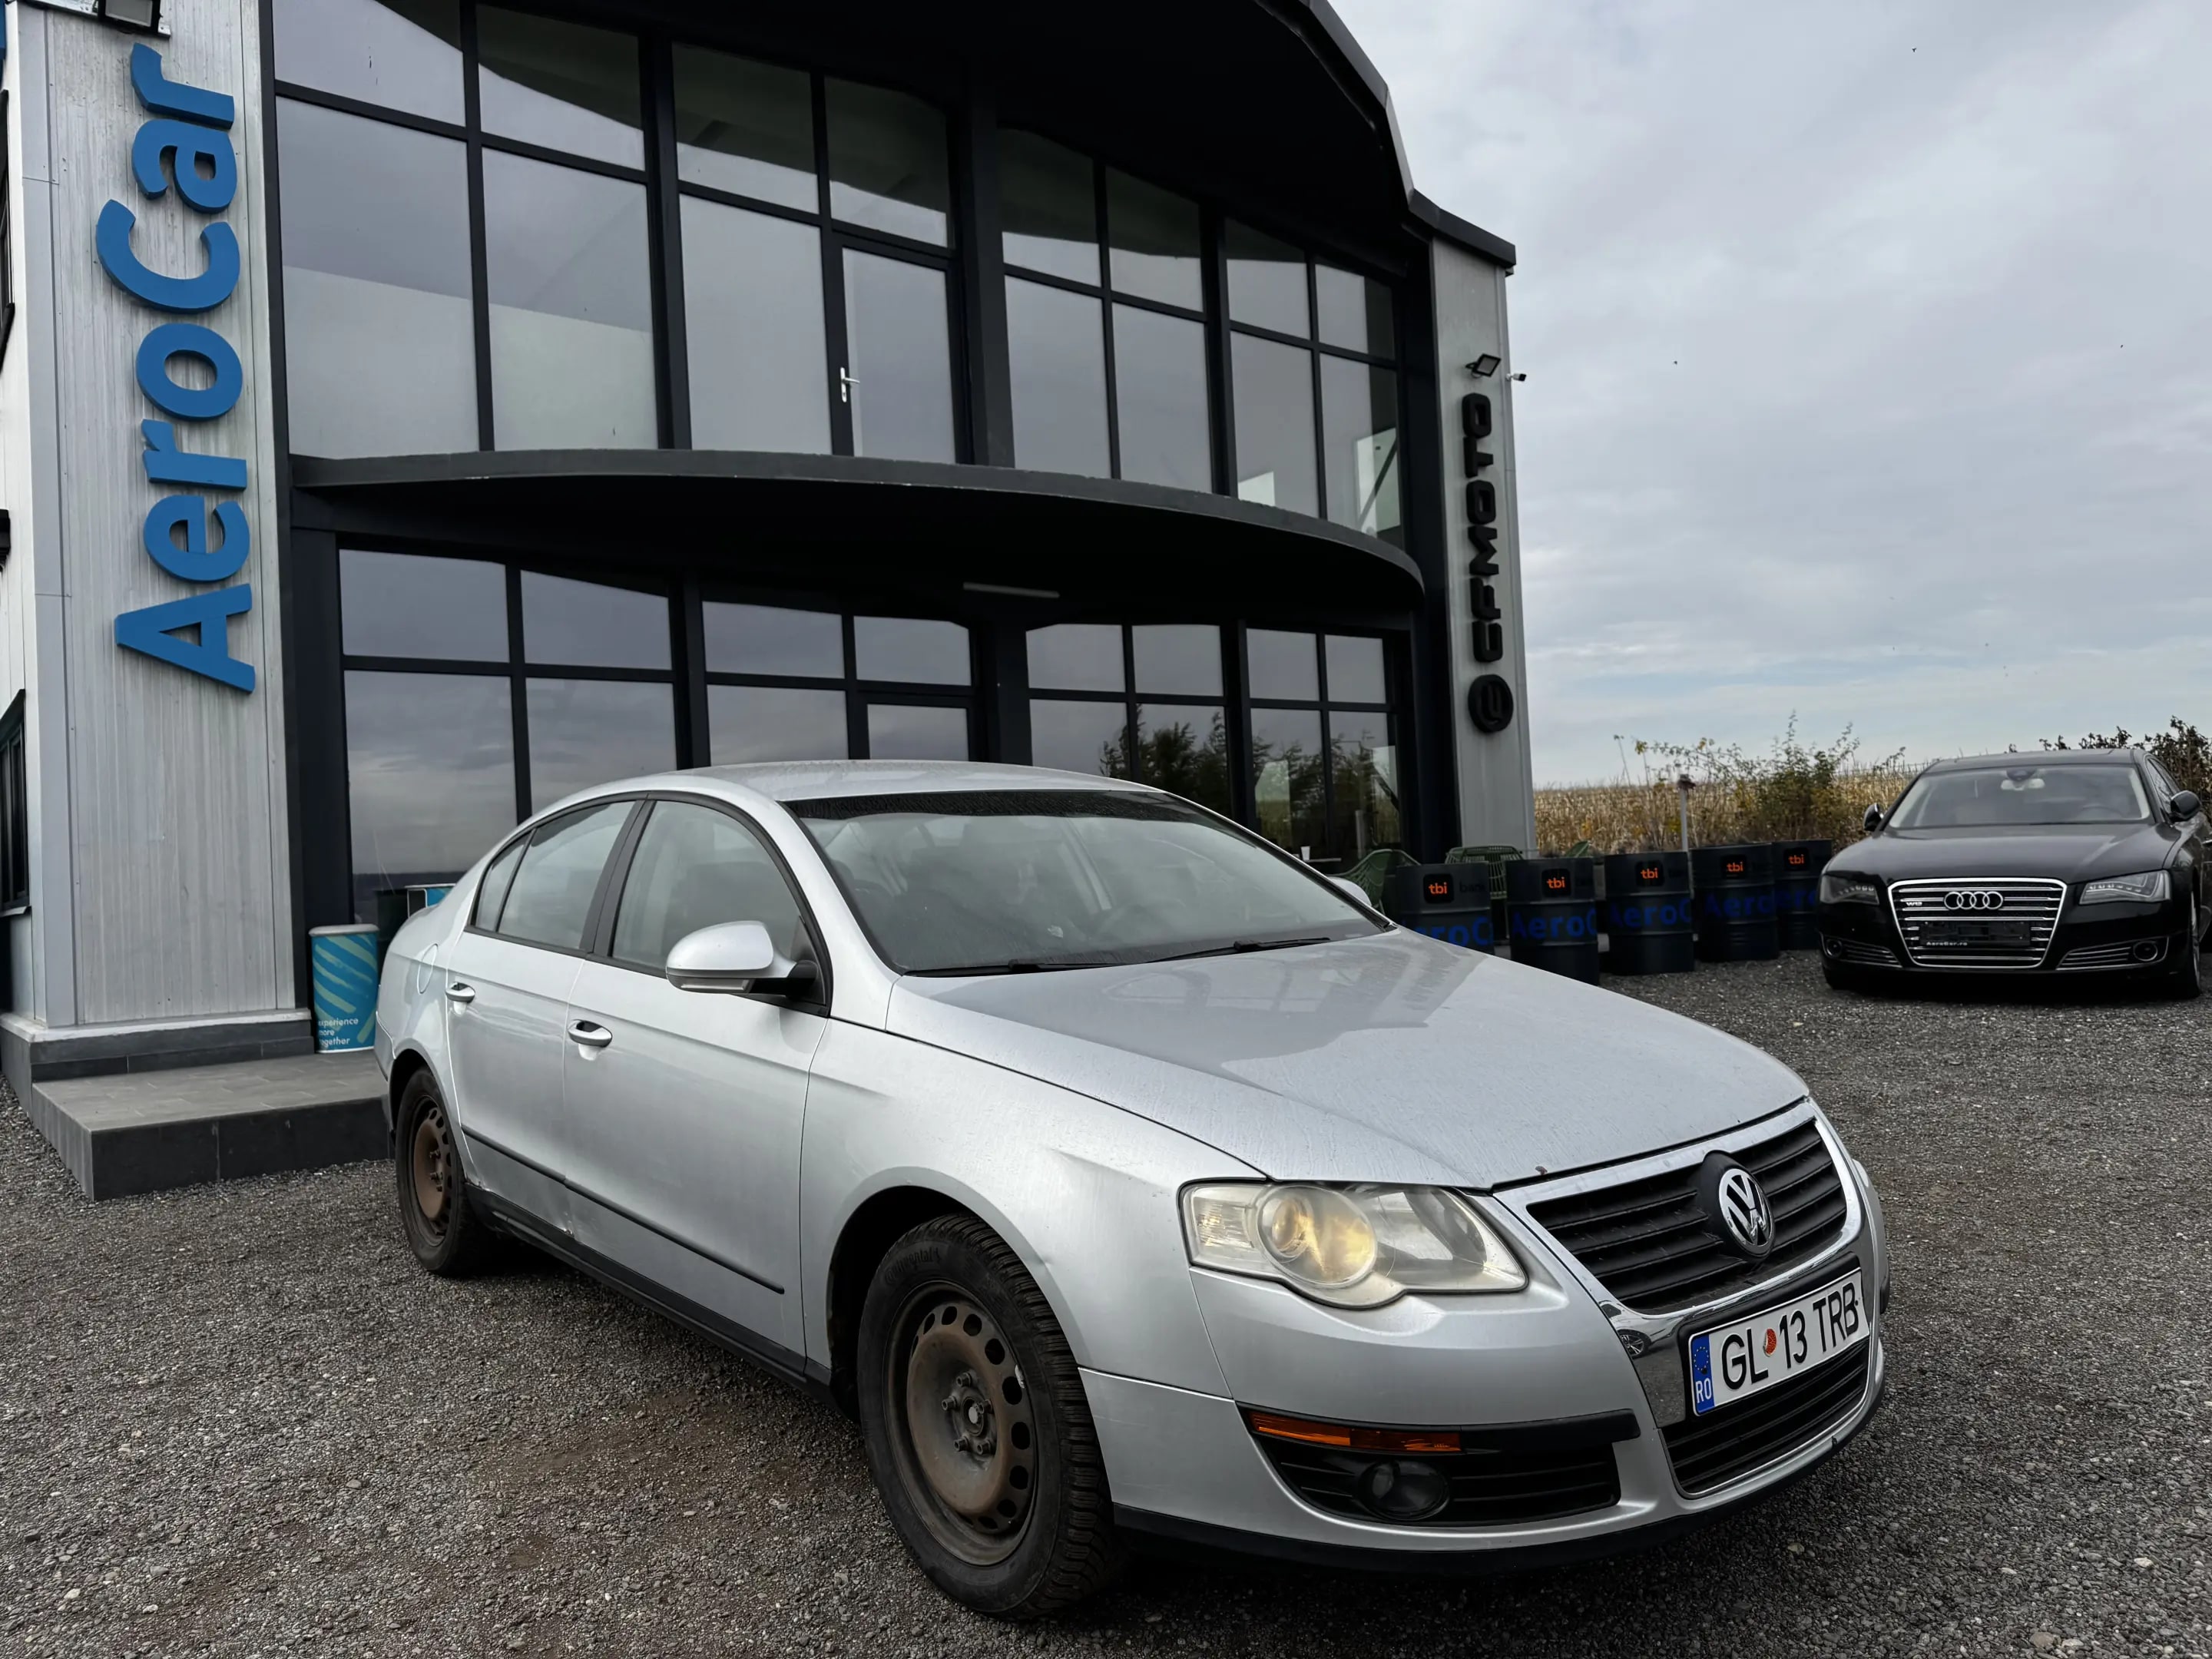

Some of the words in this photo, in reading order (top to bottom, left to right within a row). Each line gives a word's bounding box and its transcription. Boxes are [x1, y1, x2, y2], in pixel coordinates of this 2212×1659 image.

[96, 43, 256, 694] AeroCar
[1462, 392, 1504, 663] CFMOTO
[1787, 853, 1806, 865] tbi
[1640, 866, 1660, 879] tbi
[1726, 860, 1745, 873] tbi
[1428, 881, 1448, 895] tbi
[1545, 876, 1566, 889] tbi
[1721, 1328, 1769, 1391] GL
[1779, 1310, 1808, 1369] 13
[1813, 1282, 1859, 1353] TRB
[1695, 1377, 1713, 1404] RO
